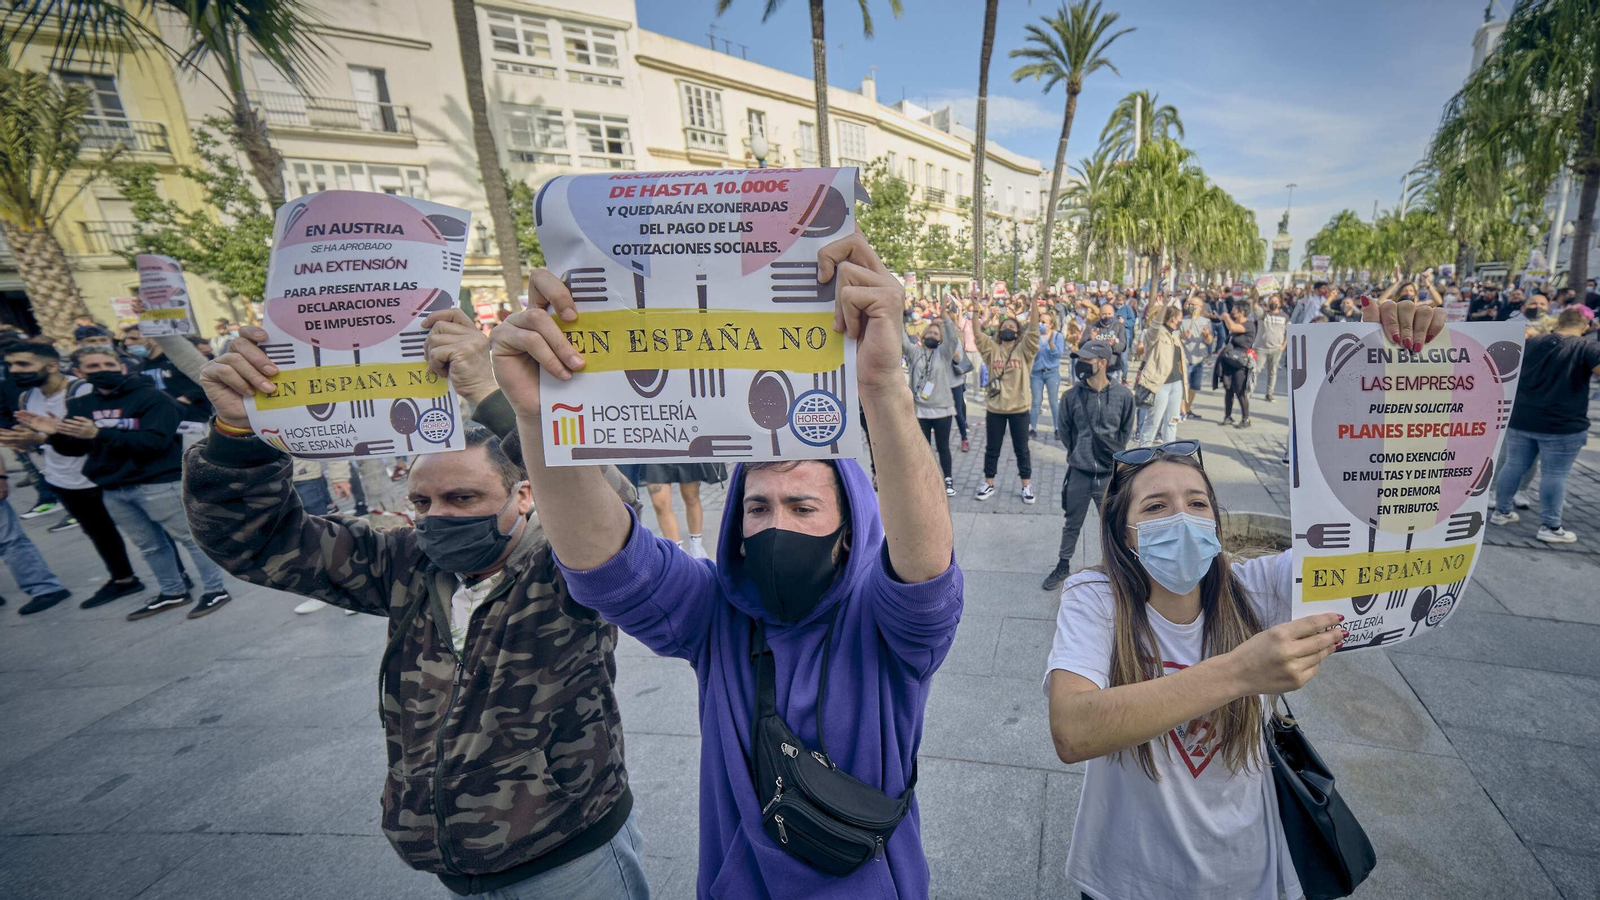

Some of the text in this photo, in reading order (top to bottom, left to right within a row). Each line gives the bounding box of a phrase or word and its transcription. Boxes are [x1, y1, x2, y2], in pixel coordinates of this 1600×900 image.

[609, 179, 790, 199] DE HASTA 10.000€
[607, 201, 788, 217] Y QUEDARÁN EXONERADAS
[305, 222, 404, 237] EN AUSTRIA
[639, 222, 753, 235] DEL PAGO DE LAS
[311, 243, 392, 253] SE HA APROBADO
[612, 242, 781, 256] COTIZACIONES SOCIALES.
[294, 257, 408, 275] UNA EXTENSIÓN
[284, 282, 418, 298] PARA PRESENTAR LAS
[298, 298, 400, 314] DECLARACIONES
[305, 314, 395, 330] DE IMPUESTOS.
[563, 323, 827, 353] EN ESPAÑA NO
[1367, 348, 1392, 364] EN
[308, 371, 397, 395] ESPAÑA
[408, 370, 438, 386] NO
[1362, 376, 1474, 392] LAS EMPRESAS
[592, 400, 697, 422] HOSTELERÍA
[1369, 403, 1464, 414] PUEDEN SOLICITAR
[284, 421, 356, 439] HOSTELERÍA
[594, 429, 618, 444] DE
[1338, 422, 1486, 439] PLANES ESPECIALES
[290, 442, 308, 451] DE
[1369, 449, 1455, 464] COMO EXENCIÓN
[1343, 467, 1473, 481] DE MULTAS Y DE INTERESES
[1377, 486, 1441, 498] POR DEMORA
[1377, 502, 1440, 515] EN TRIBUTOS.
[1312, 553, 1465, 588] EN ESPAÑA NO
[1342, 630, 1373, 644] SPAÑA
